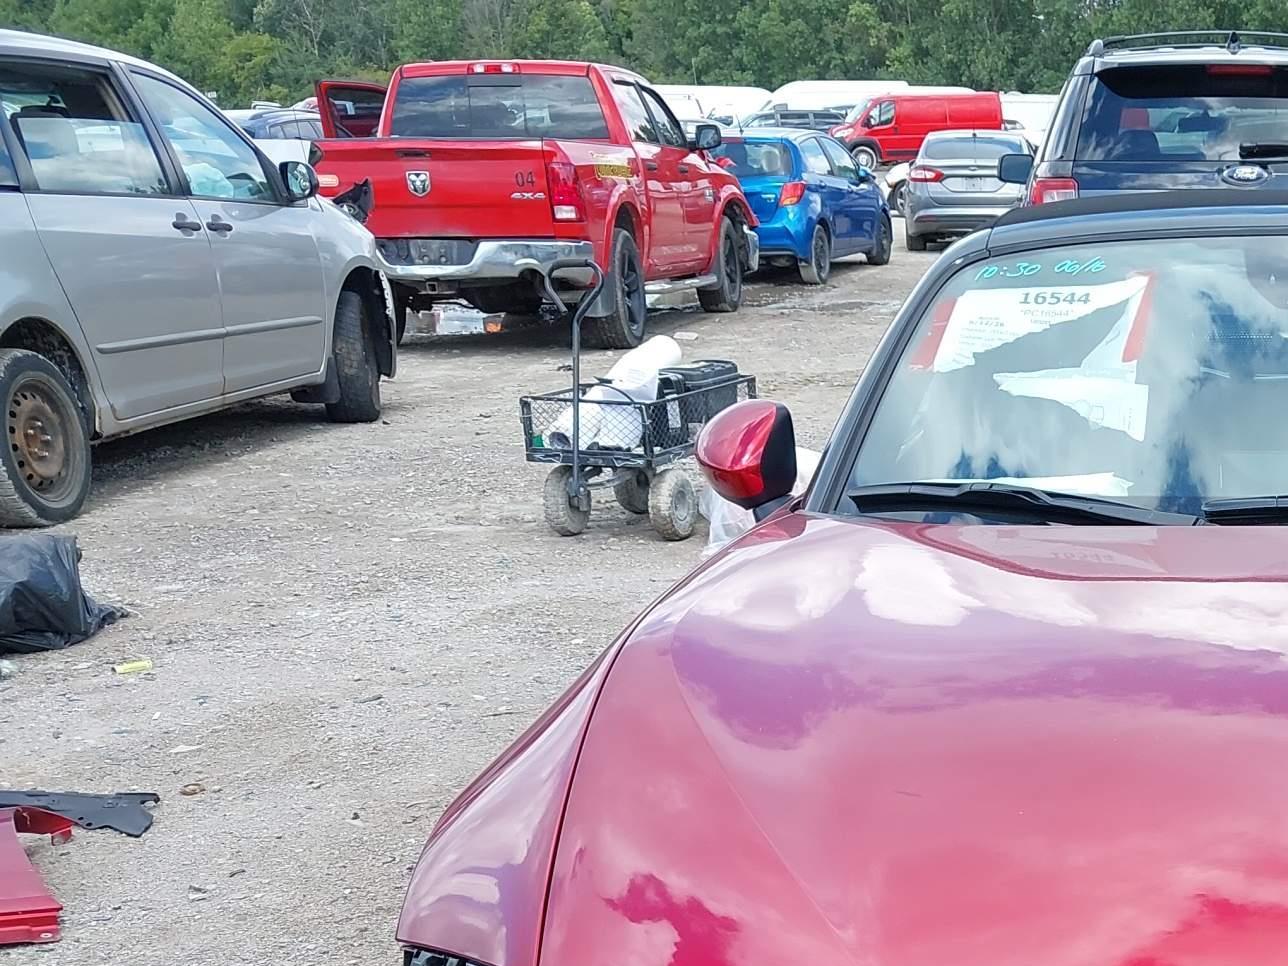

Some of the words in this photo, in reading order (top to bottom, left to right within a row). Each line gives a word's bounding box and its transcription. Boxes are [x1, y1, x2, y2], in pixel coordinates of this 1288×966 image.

[515, 171, 535, 187] 04
[975, 262, 1041, 281] 10:30
[1018, 291, 1092, 305] 16544
